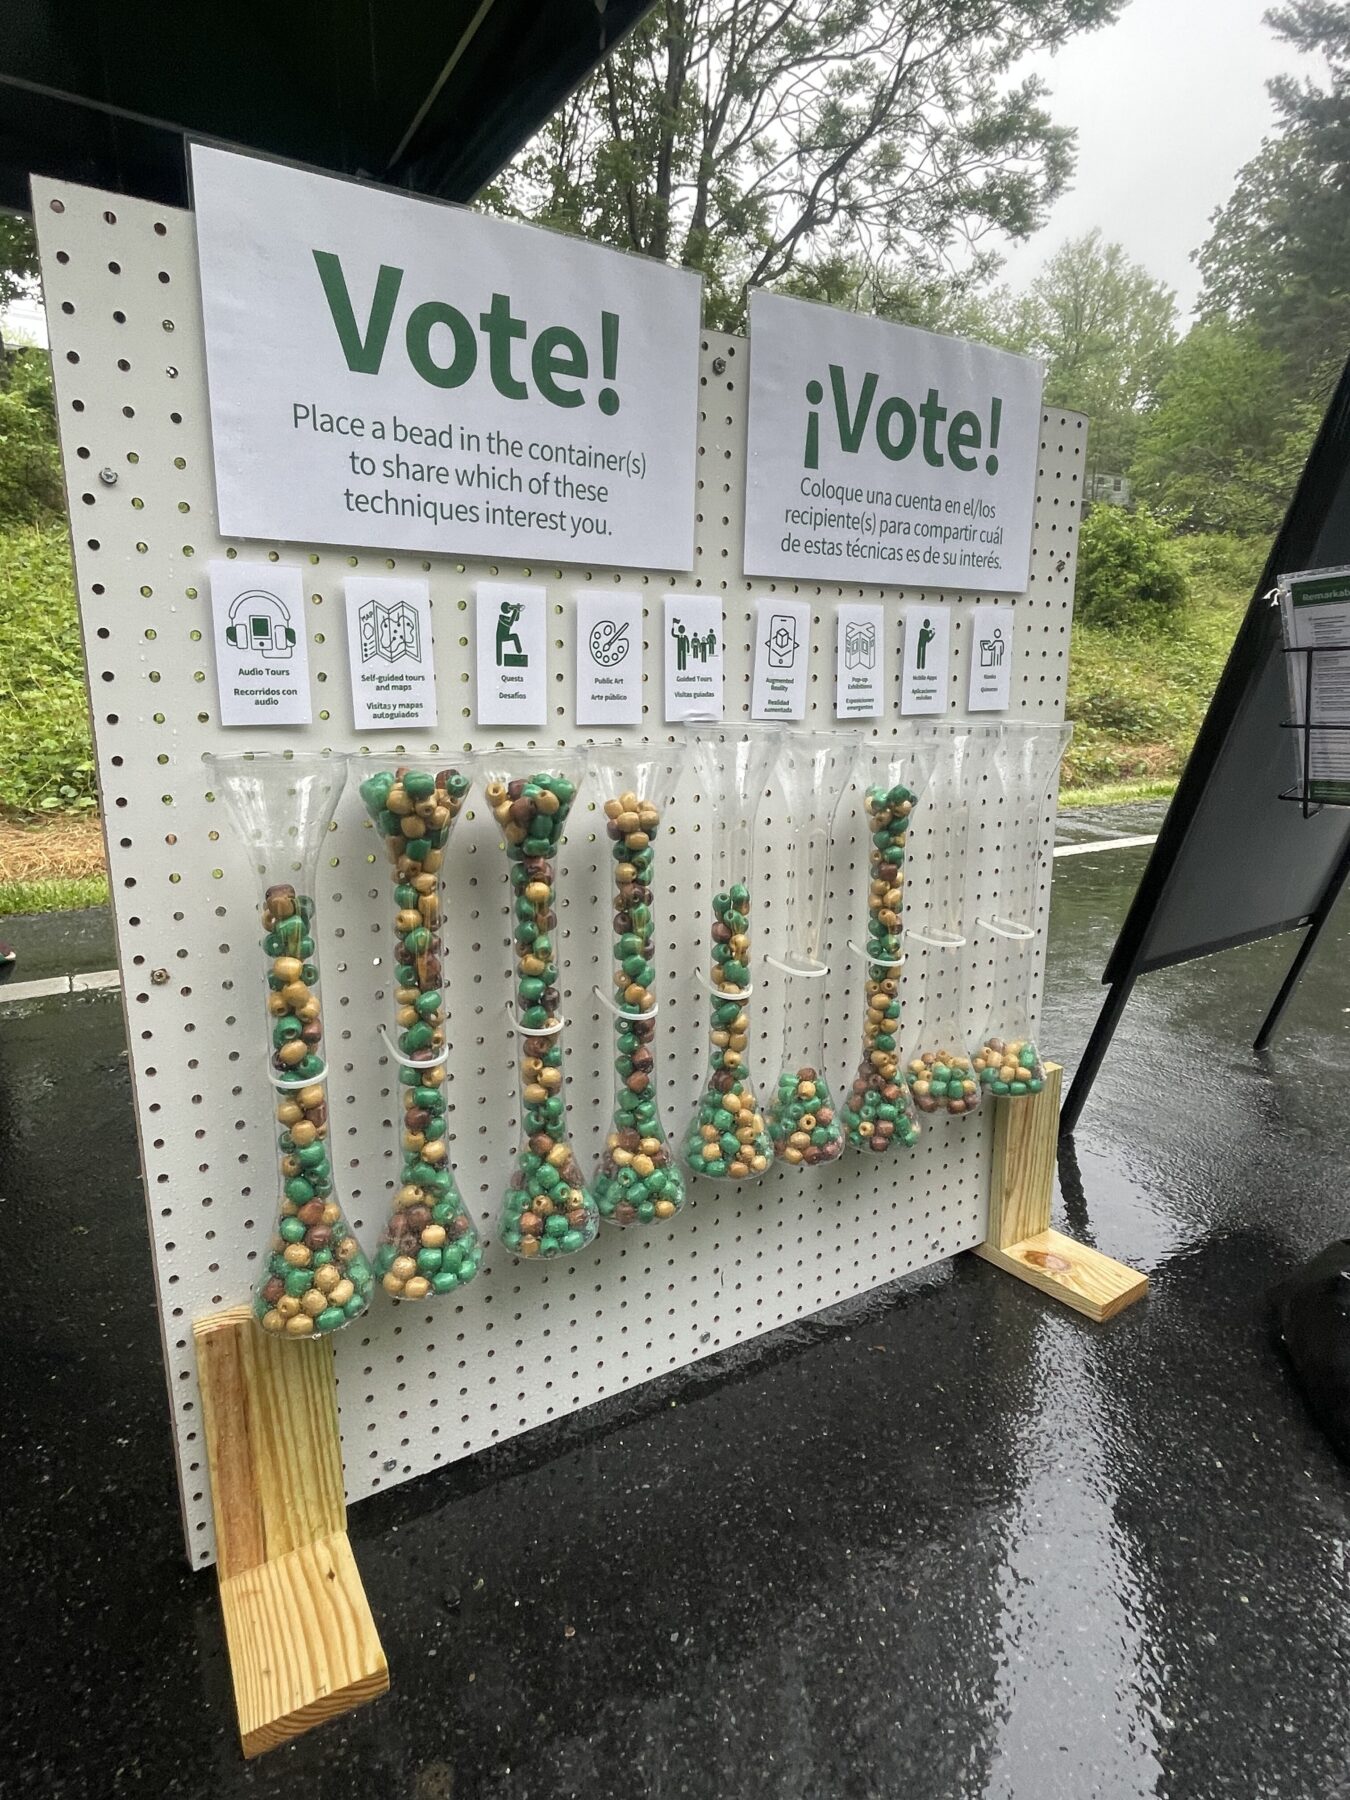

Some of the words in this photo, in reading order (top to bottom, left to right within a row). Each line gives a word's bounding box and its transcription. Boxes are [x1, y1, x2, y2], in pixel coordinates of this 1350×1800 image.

[312, 249, 620, 416] Vote!
[804, 364, 1002, 476] ¡Vote!
[293, 403, 365, 437] Place
[372, 418, 386, 440] a
[393, 416, 453, 450] bead
[460, 426, 481, 453] in
[486, 430, 523, 458] the
[528, 443, 647, 480] container(s)
[349, 450, 376, 476] to
[382, 454, 449, 485] share
[455, 461, 522, 494] which
[528, 470, 553, 496] of
[554, 473, 609, 503] these
[344, 488, 480, 526] techniques
[485, 501, 567, 532] interest
[570, 514, 613, 538] you.
[800, 477, 863, 505] Coloque
[866, 488, 892, 506] una
[895, 492, 942, 512] cuenta
[945, 498, 961, 514] en
[963, 498, 996, 520] el/los
[785, 506, 876, 536] recipiente(s)
[880, 517, 911, 541] para
[914, 522, 978, 544] compartir
[979, 526, 1003, 545] cuál
[781, 532, 800, 552] de
[803, 538, 843, 556] estas
[846, 539, 903, 562] técnicas
[906, 548, 921, 563] es
[923, 545, 941, 565] de
[943, 552, 957, 567] su
[959, 549, 1003, 570] interés.
[238, 667, 264, 676] Audio
[265, 668, 290, 676] Tours
[361, 673, 404, 684] Self-guided
[405, 674, 426, 682] tours
[391, 684, 412, 692] maps
[233, 687, 281, 696] Recorridos
[281, 688, 298, 696] con
[254, 698, 279, 706] audio
[366, 702, 391, 710] Visitas
[398, 702, 424, 710] mapas
[372, 711, 419, 720] autoguiados
